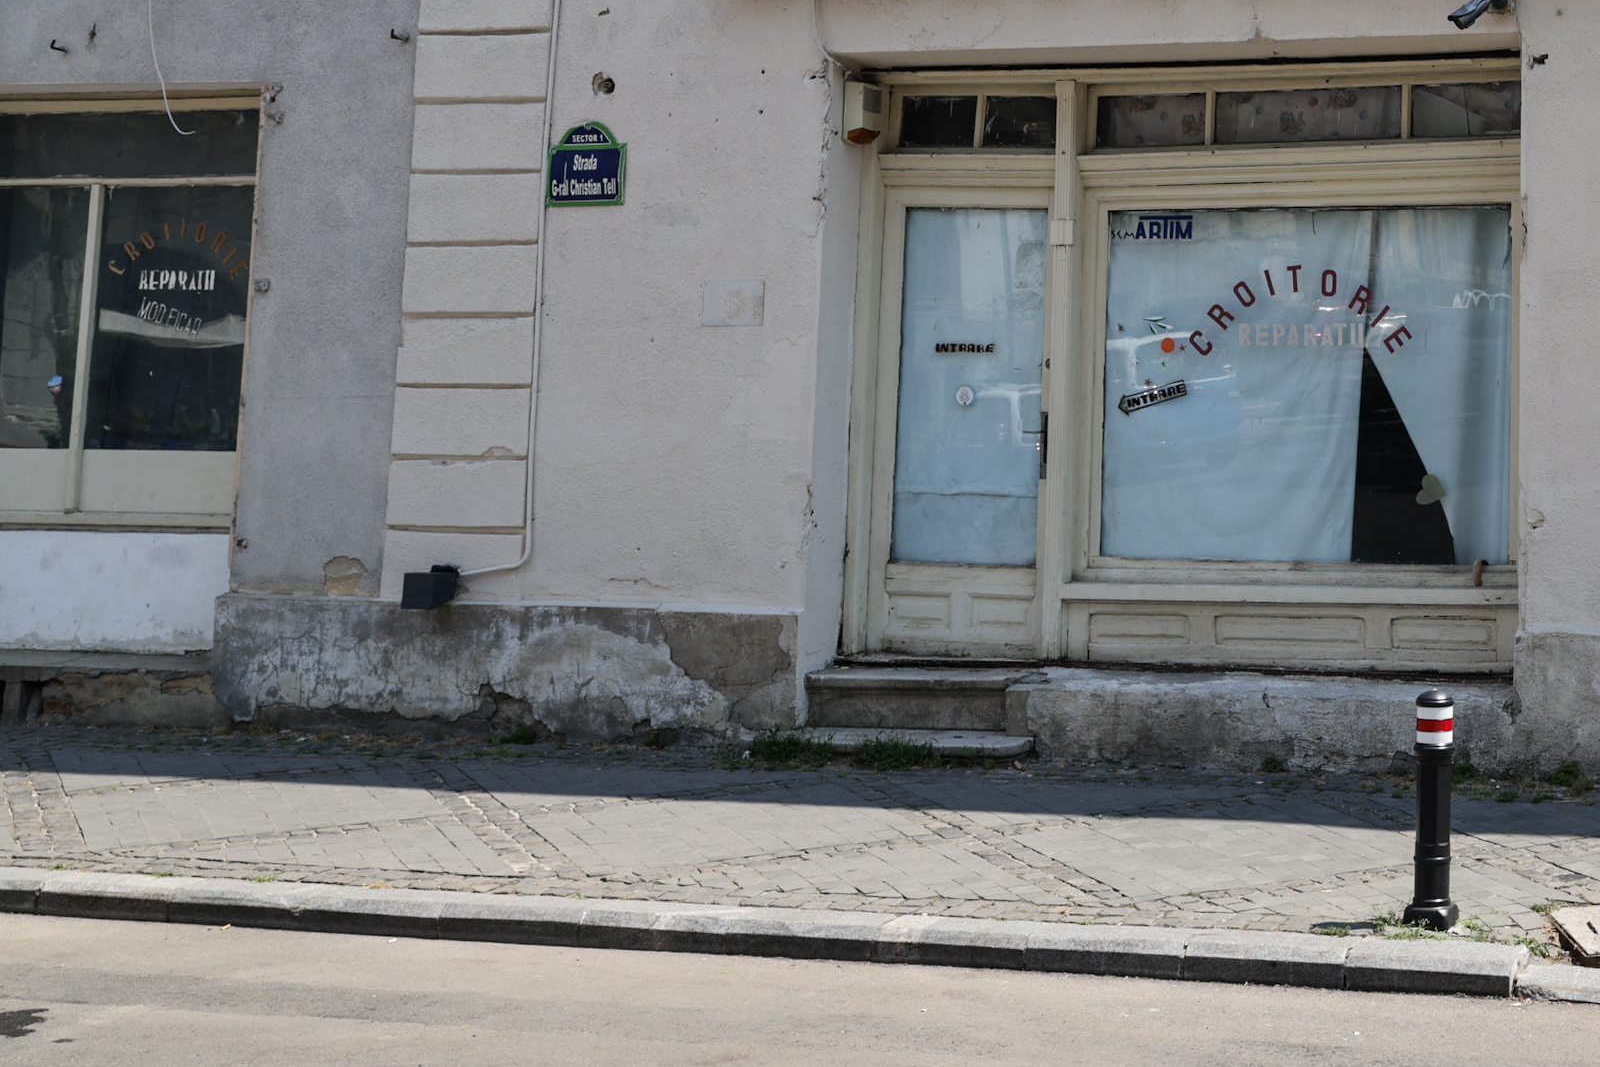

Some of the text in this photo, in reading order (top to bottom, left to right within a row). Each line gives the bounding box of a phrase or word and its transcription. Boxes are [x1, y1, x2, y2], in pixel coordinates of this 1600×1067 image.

[572, 134, 603, 143] SECTOR 1
[573, 154, 598, 171] Strada
[570, 178, 601, 196] Christian
[603, 177, 617, 195] Tell
[1189, 265, 1413, 356] CROITORIE
[935, 343, 995, 353] INTRARE
[1126, 383, 1187, 408] INTRARE
